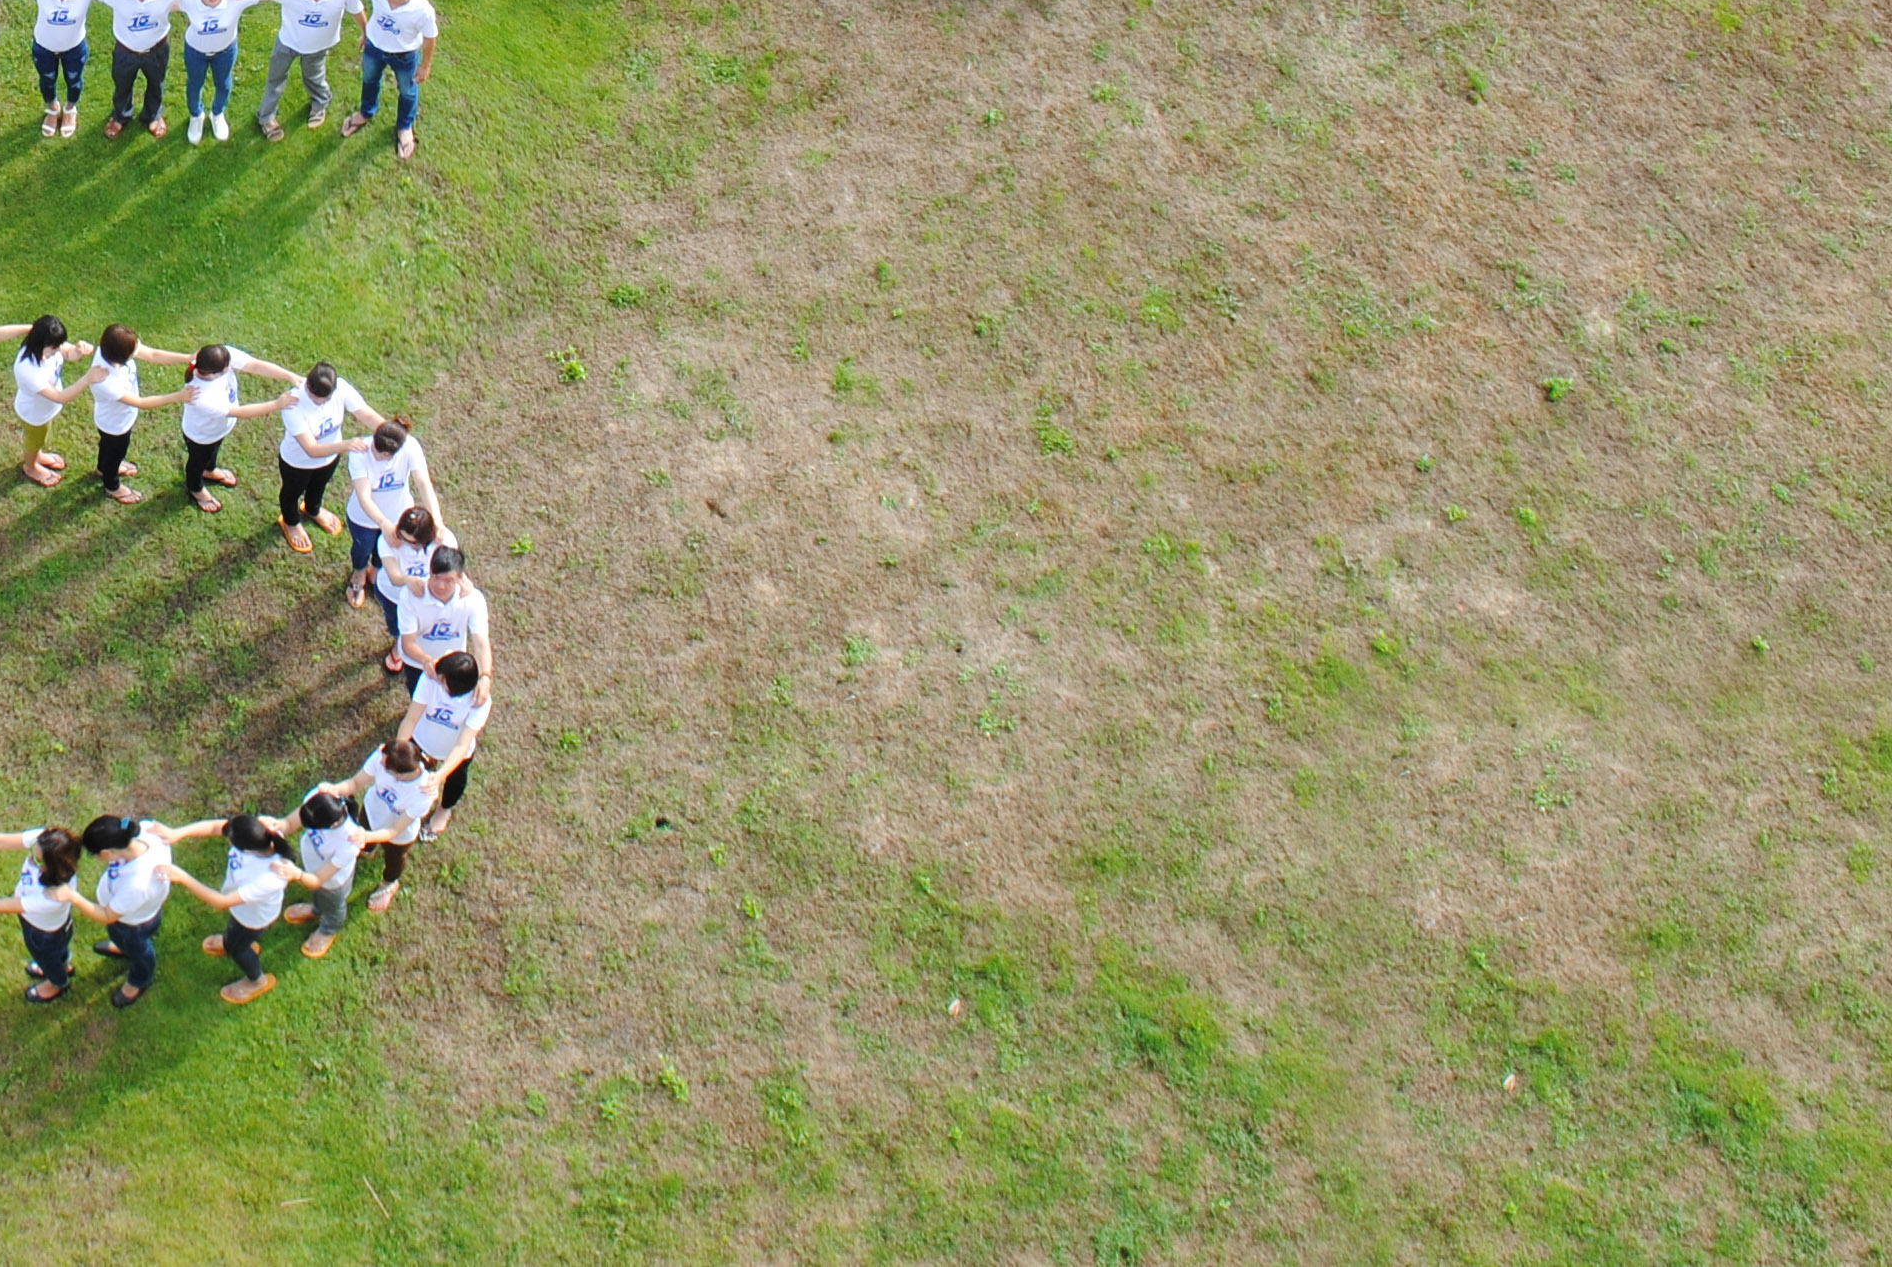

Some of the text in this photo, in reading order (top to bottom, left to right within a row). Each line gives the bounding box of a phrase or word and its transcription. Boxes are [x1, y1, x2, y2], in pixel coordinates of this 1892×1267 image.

[51, 10, 69, 22] 15
[132, 15, 149, 28] 15
[304, 13, 322, 23] 15
[202, 19, 219, 32] 15
[378, 473, 395, 489] 15
[431, 623, 452, 636] 15
[435, 708, 453, 721] 15
